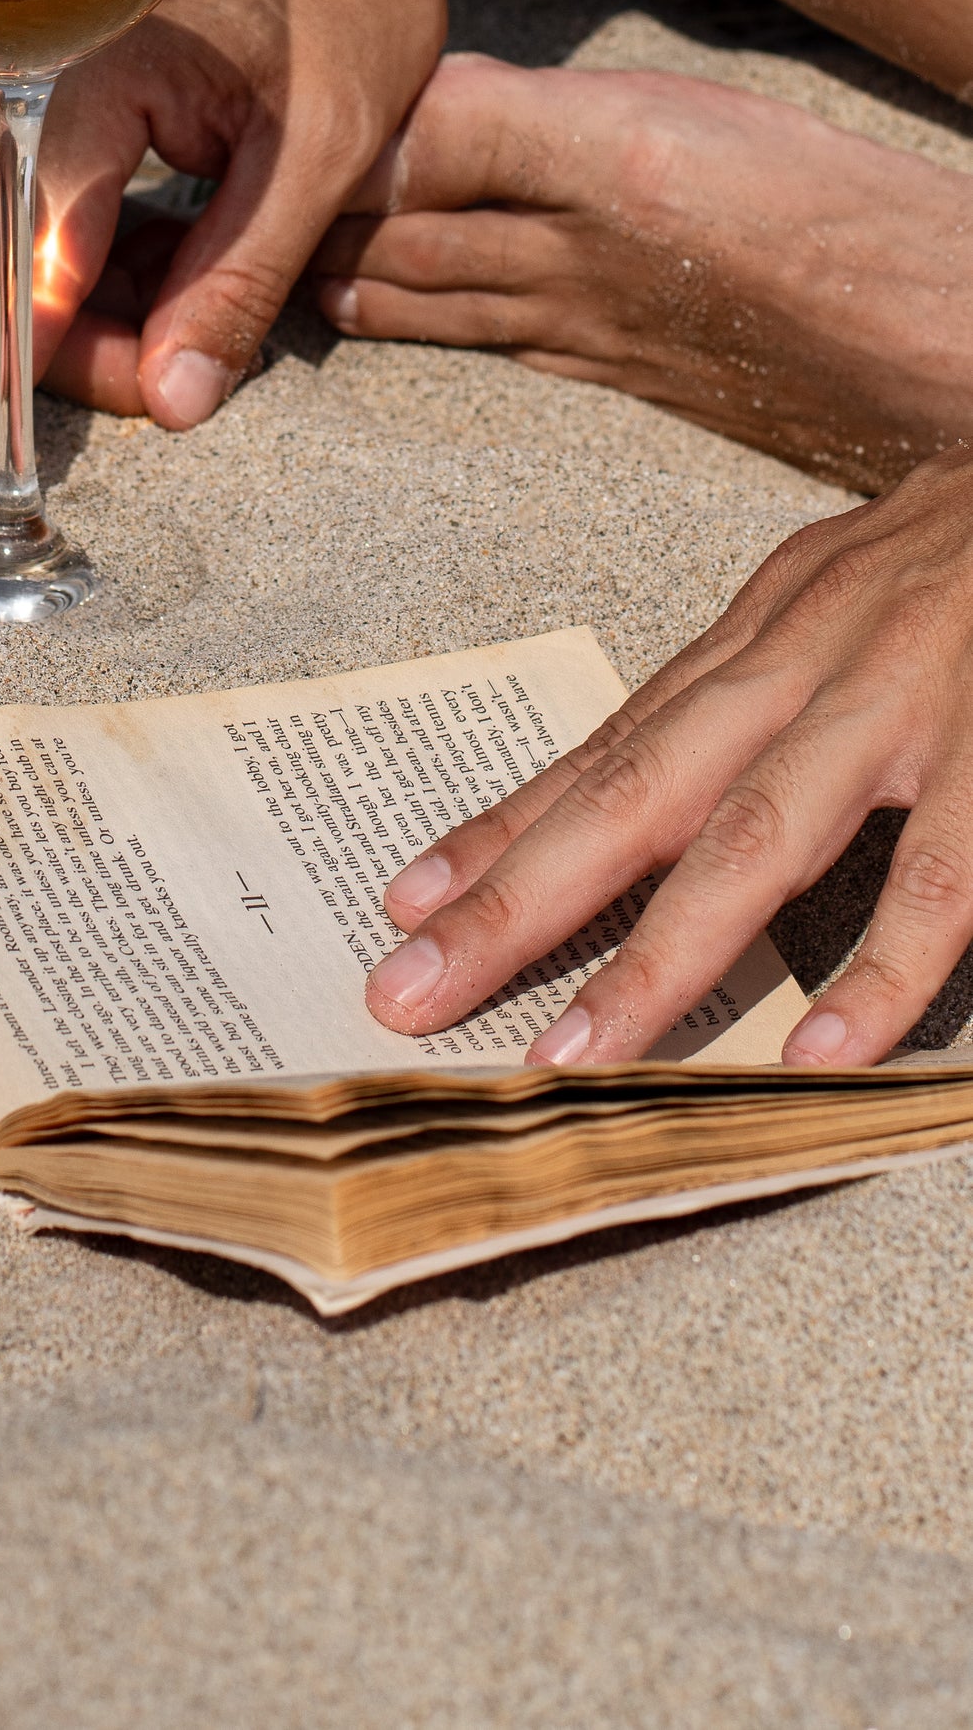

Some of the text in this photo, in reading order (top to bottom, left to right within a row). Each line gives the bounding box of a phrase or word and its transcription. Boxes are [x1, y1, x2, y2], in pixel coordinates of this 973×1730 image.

[354, 704, 375, 723] my
[375, 700, 409, 745] besides
[505, 674, 555, 747] always have
[222, 723, 247, 743] got
[363, 725, 385, 744] off
[439, 689, 495, 772] almost every
[10, 738, 26, 752] in
[29, 737, 46, 750] at
[15, 752, 41, 782] club
[39, 752, 63, 776] can
[378, 746, 400, 768] her
[405, 747, 433, 786] mean,
[1, 767, 22, 792] buy
[243, 755, 272, 794] lobby,
[391, 768, 415, 789] get
[31, 783, 59, 818] night
[52, 778, 77, 803] you
[75, 781, 104, 822] unless
[289, 714, 390, 879] her and Stradlater sitting in
[15, 794, 41, 818] you
[265, 796, 284, 817] the
[428, 796, 452, 821] did.
[1, 808, 25, 840] have
[29, 821, 50, 844] lets
[51, 820, 72, 845] any
[66, 806, 95, 848] unless
[98, 826, 115, 845] Or
[278, 820, 293, 834] to
[18, 842, 43, 866] you
[285, 835, 306, 857] out
[7, 861, 27, 887] was
[42, 846, 71, 886] waiter
[88, 850, 112, 880] time
[110, 850, 142, 892] drunk.
[300, 860, 323, 885] way
[20, 888, 36, 898] it
[33, 869, 63, 909] unless
[66, 888, 85, 909] the
[81, 876, 110, 913] There
[105, 881, 131, 909] long
[318, 888, 339, 908] my
[3, 893, 39, 944] anyway,
[30, 900, 61, 937] place,
[56, 911, 73, 925] in
[136, 896, 161, 916] get
[332, 910, 349, 926] on
[66, 928, 83, 944] be
[78, 911, 109, 949] unless
[105, 915, 135, 957] Cokes.
[129, 922, 149, 941] for
[147, 920, 174, 943] and
[32, 947, 50, 963] up
[48, 938, 73, 963] first
[77, 946, 93, 959] to
[102, 950, 119, 964] or
[125, 833, 285, 1070] with some girl that really knocks you out.
[143, 942, 159, 956] in
[42, 965, 58, 975] it
[66, 964, 86, 984] the
[129, 958, 156, 978] just
[151, 957, 170, 972] sit
[168, 946, 200, 982] liquor
[15, 957, 58, 1013] Lavender
[80, 985, 96, 999] In
[87, 960, 123, 1003] terrible
[114, 965, 140, 994] with,
[141, 980, 162, 993] of
[164, 973, 186, 994] can
[51, 977, 85, 1020] closing
[180, 996, 207, 1018] you
[195, 985, 225, 1015] some
[92, 1000, 114, 1025] ago.
[116, 1005, 141, 1032] very
[135, 996, 166, 1031] dance
[152, 995, 193, 1035] instead
[3, 1012, 29, 1042] them
[53, 1016, 73, 1036] the
[80, 1022, 105, 1051] were
[193, 1020, 226, 1053] world
[219, 1020, 243, 1042] buy
[18, 1044, 39, 1057] of
[65, 1039, 89, 1059] left
[107, 1027, 133, 1054] time
[137, 1034, 157, 1054] are
[160, 1033, 176, 1046] to
[100, 1053, 128, 1084] They
[127, 1055, 152, 1082] long
[150, 1057, 174, 1080] that
[165, 1047, 201, 1078] good
[186, 1037, 219, 1076] drinks
[222, 1055, 242, 1074] the
[237, 1045, 265, 1072] least
[33, 1058, 60, 1090] three
[59, 1060, 83, 1087] that.
